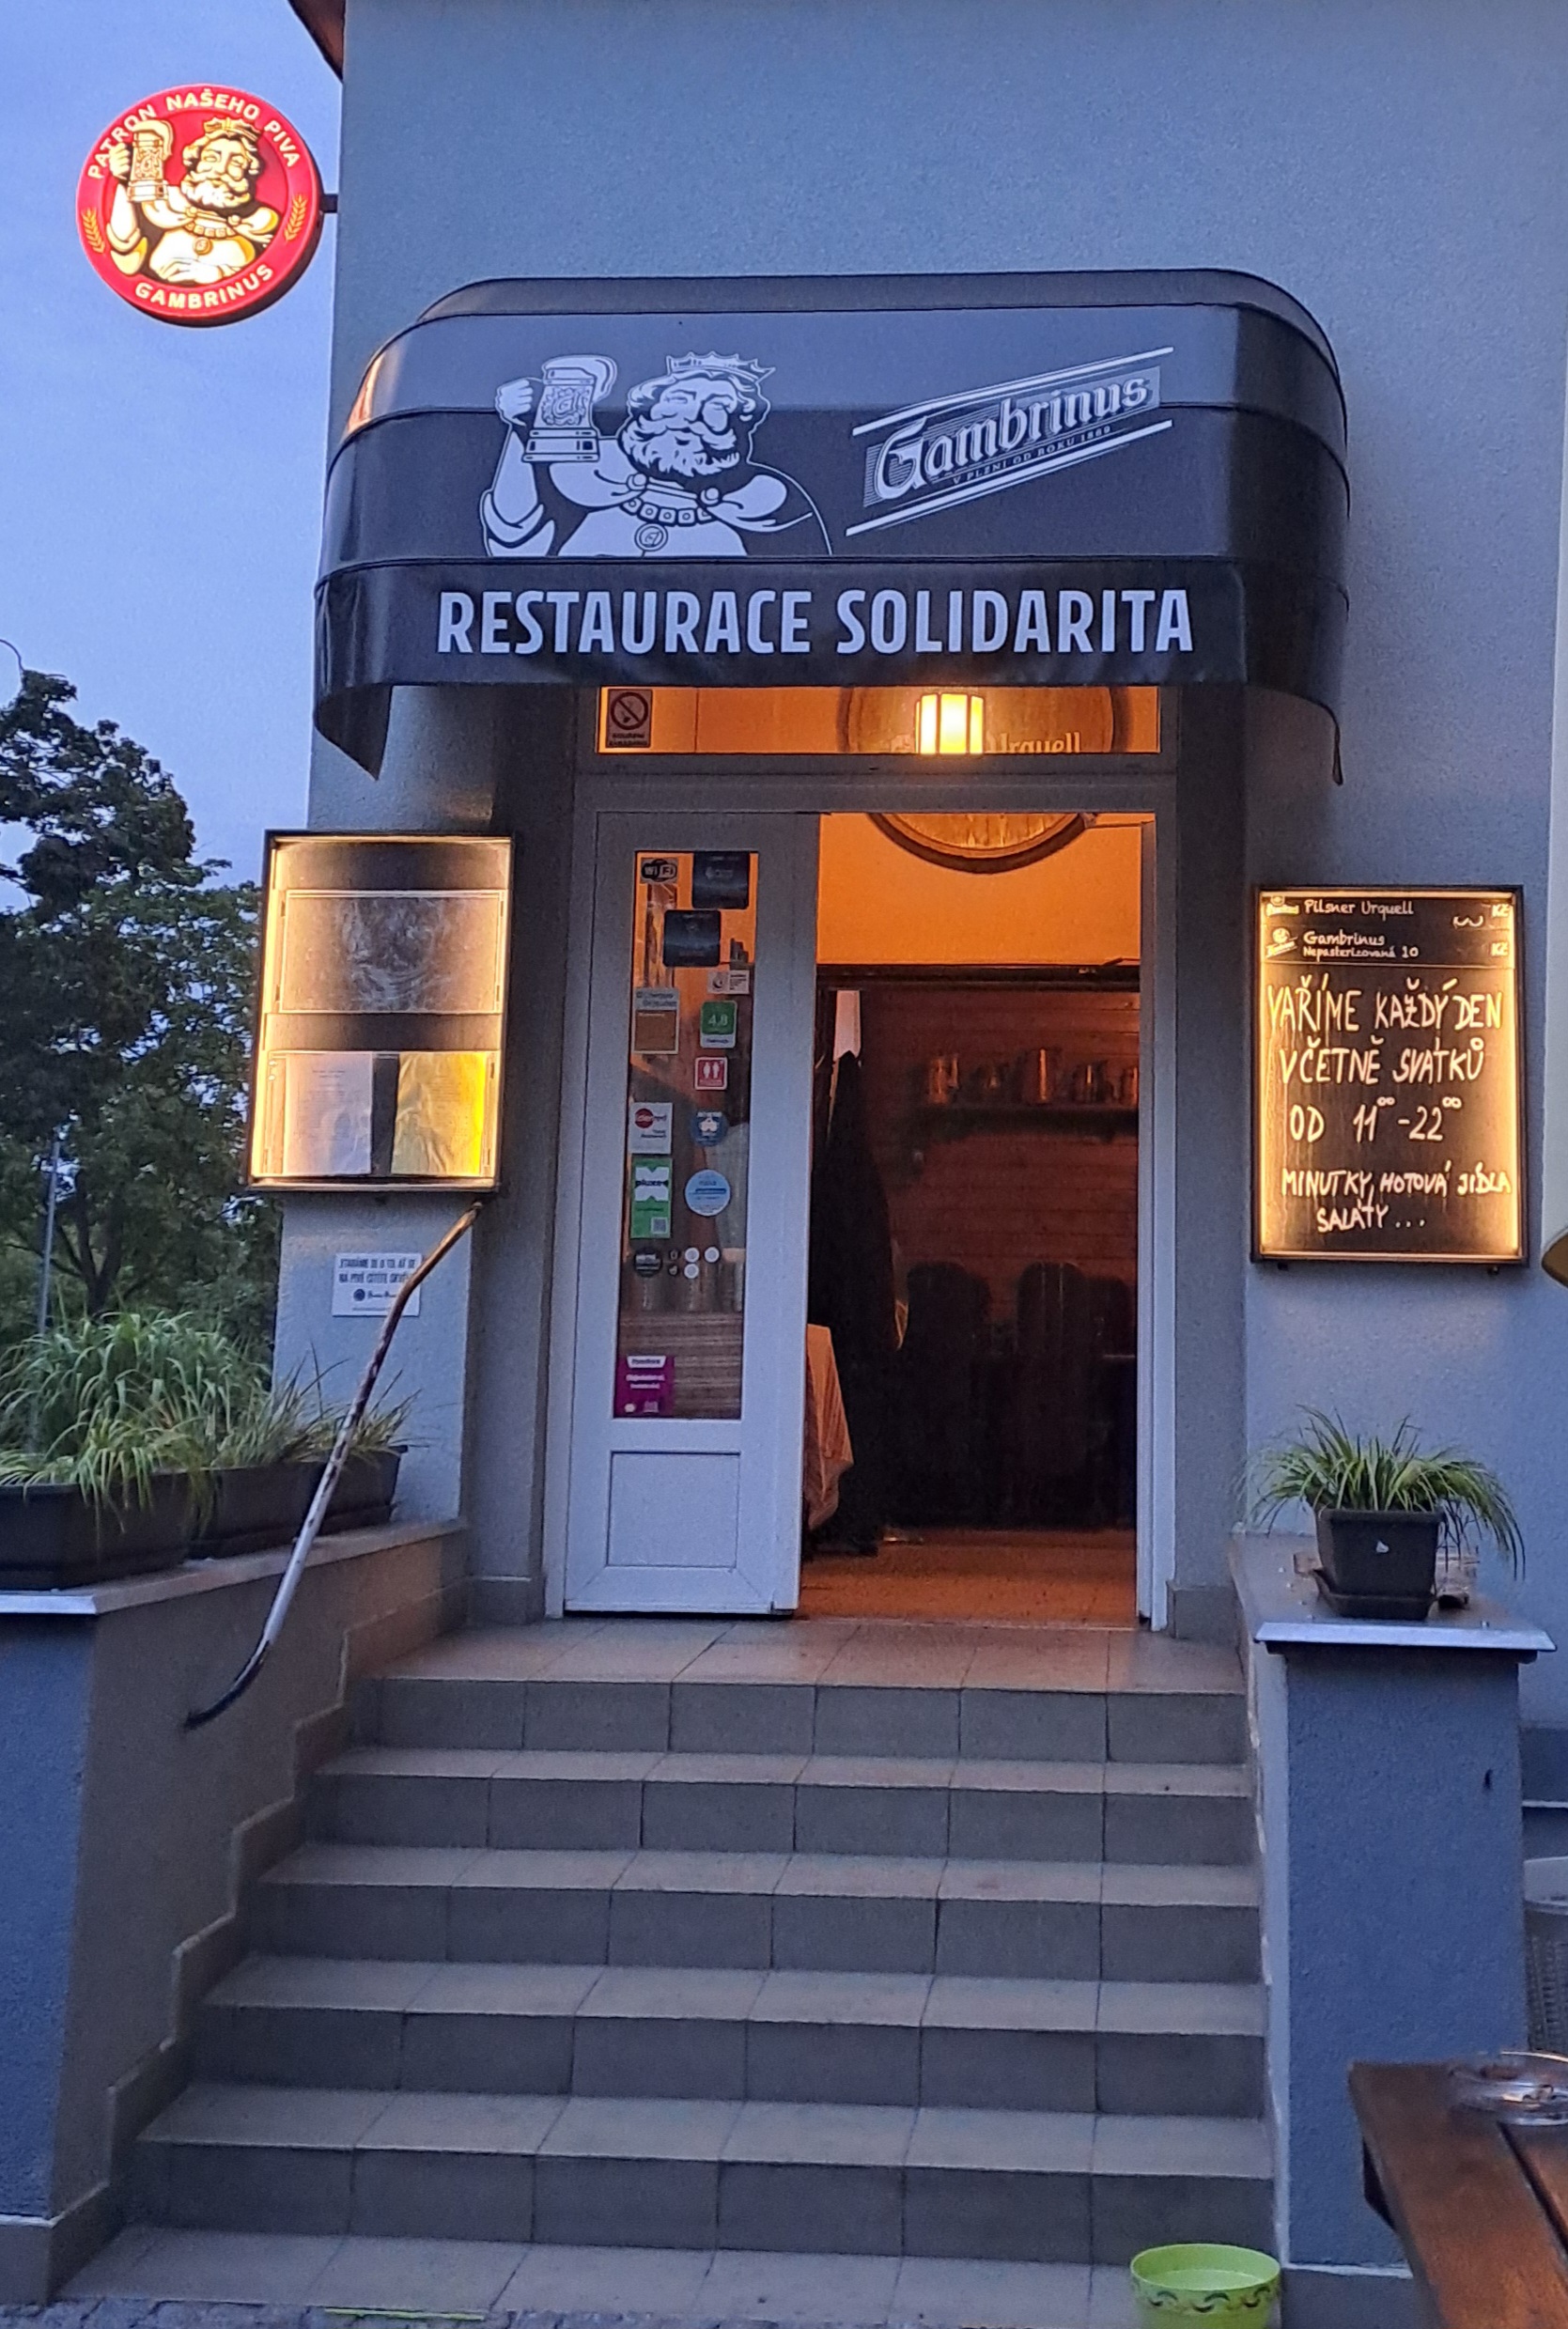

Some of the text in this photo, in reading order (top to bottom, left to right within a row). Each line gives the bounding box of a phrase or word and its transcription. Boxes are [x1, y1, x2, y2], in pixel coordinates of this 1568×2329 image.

[87, 88, 302, 179] PATRON NAŠEHO PIVA
[135, 264, 273, 310] GAMBRINUS
[875, 378, 1151, 500] Gambrinus
[1013, 453, 1032, 465] OD
[1037, 439, 1075, 457] ROKU
[438, 589, 1194, 655] RESTAURACE SOLIDARITA
[1303, 899, 1356, 914] Pilsner
[1361, 900, 1414, 921] Urquell
[1303, 929, 1386, 945] Gambrinus
[1303, 945, 1396, 962] Nepasterizovaná
[1402, 946, 1420, 958] 10
[1267, 973, 1502, 1033] VAŘÍME KAŽDÝ DEN
[1280, 1035, 1484, 1084] VČETNĚ SVÁTKŮ
[1290, 1104, 1325, 1142] OD
[1379, 1160, 1452, 1197] HOTOVÁ
[1457, 1162, 1512, 1194] JÍDLA
[1317, 1198, 1389, 1234] SALÁTY
